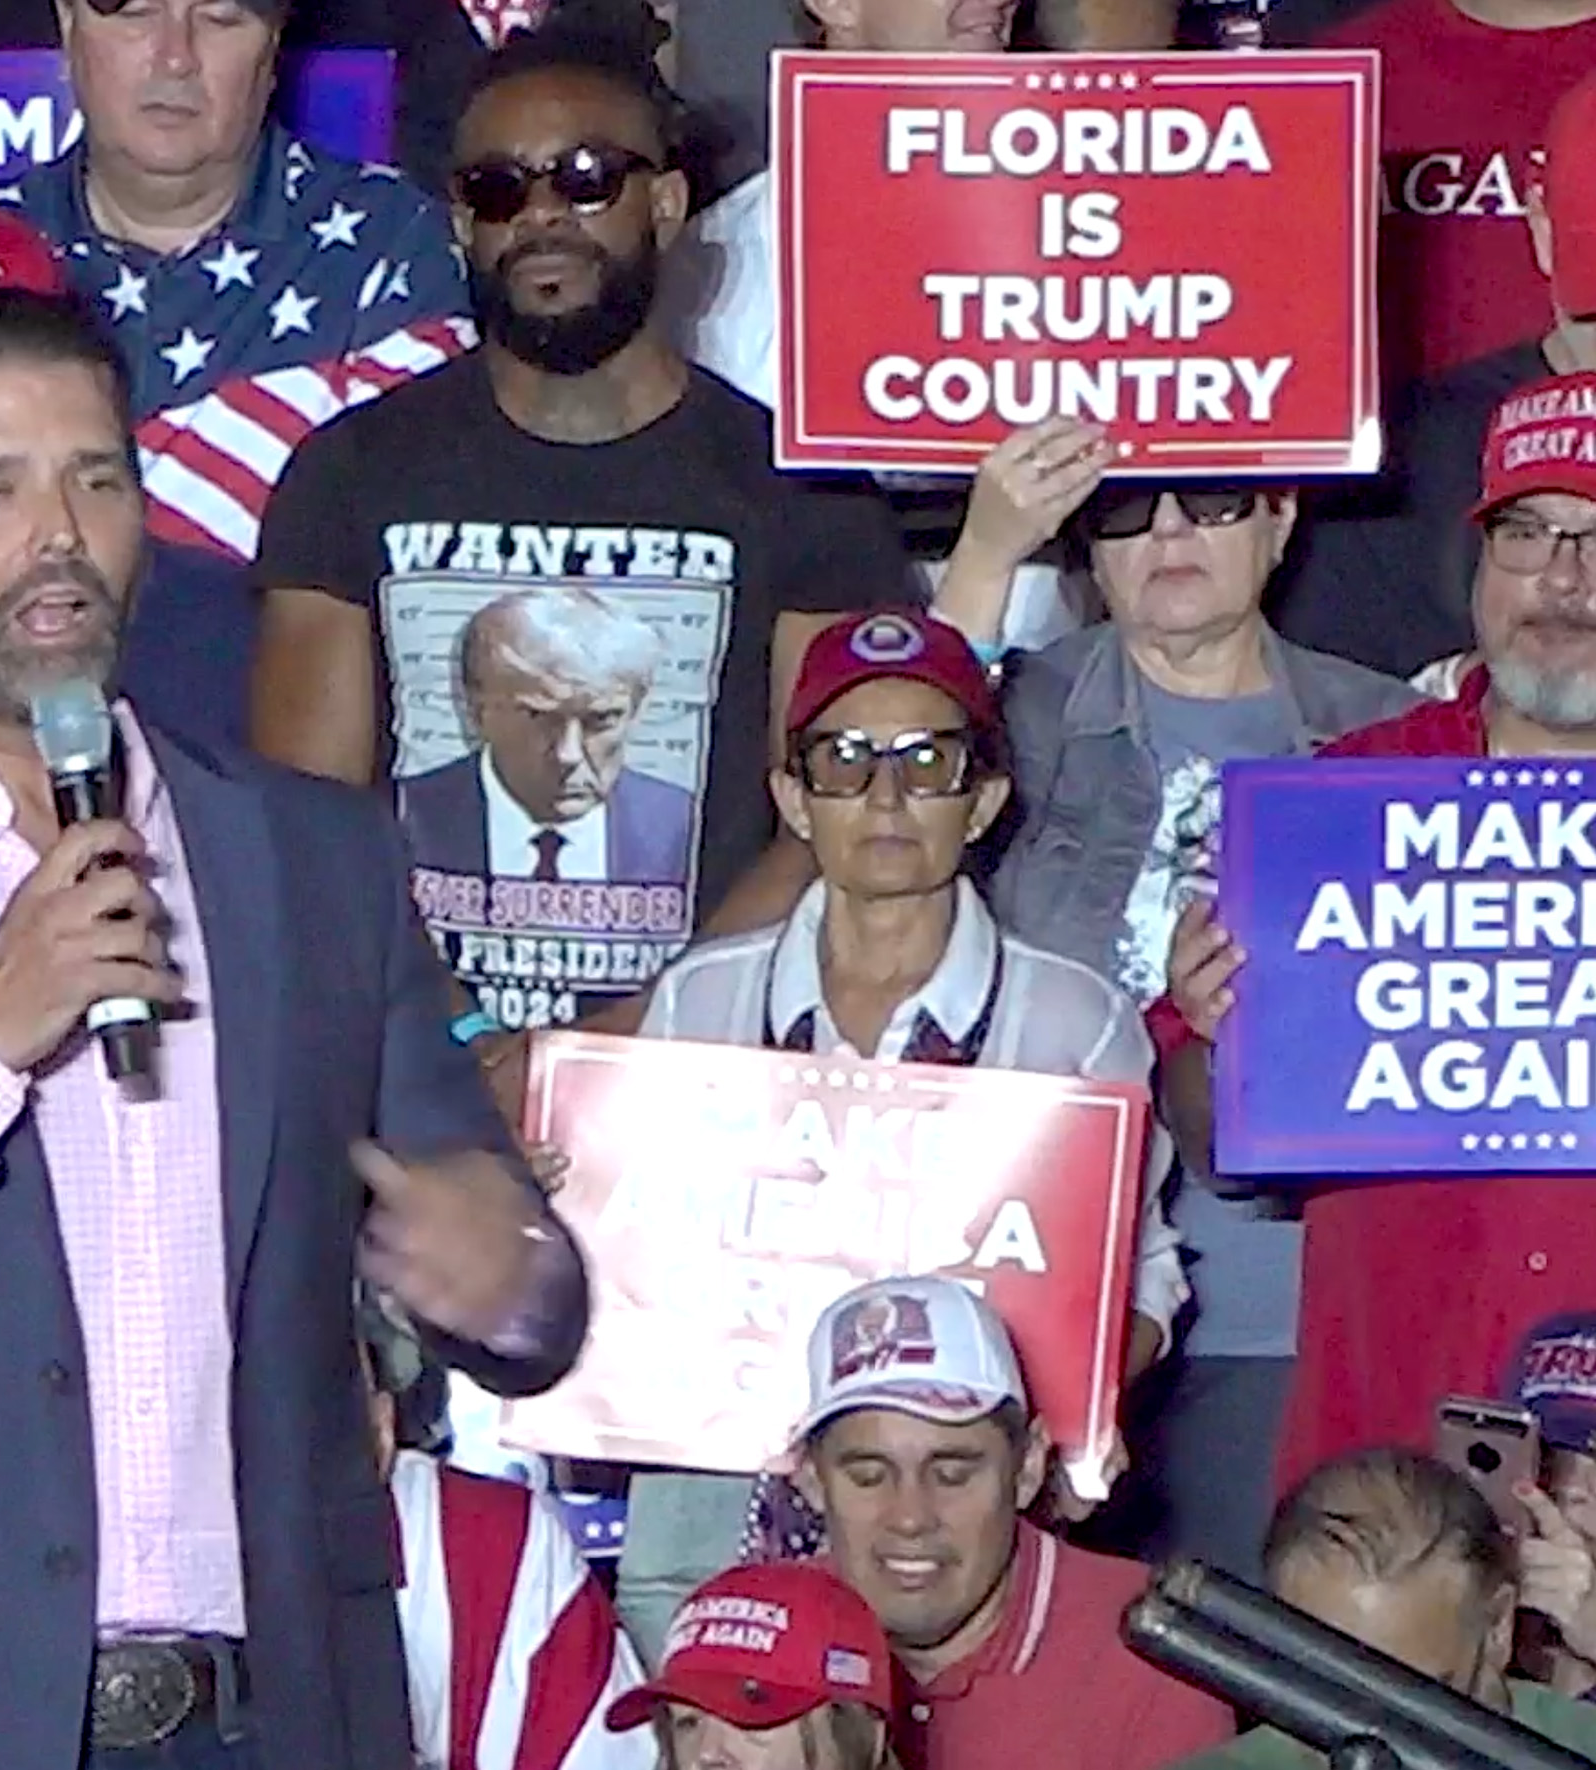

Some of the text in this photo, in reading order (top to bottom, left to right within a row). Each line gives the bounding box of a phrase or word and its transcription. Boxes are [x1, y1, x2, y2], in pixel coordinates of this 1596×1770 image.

[887, 106, 1272, 175] FLORIDA
[1040, 192, 1122, 258] IS
[923, 274, 1233, 342] TRUMP
[864, 356, 1293, 424] COUNTRY
[382, 521, 736, 582] WANTED
[489, 880, 687, 933] SURRENDER
[1344, 1038, 1591, 1112] AGAI
